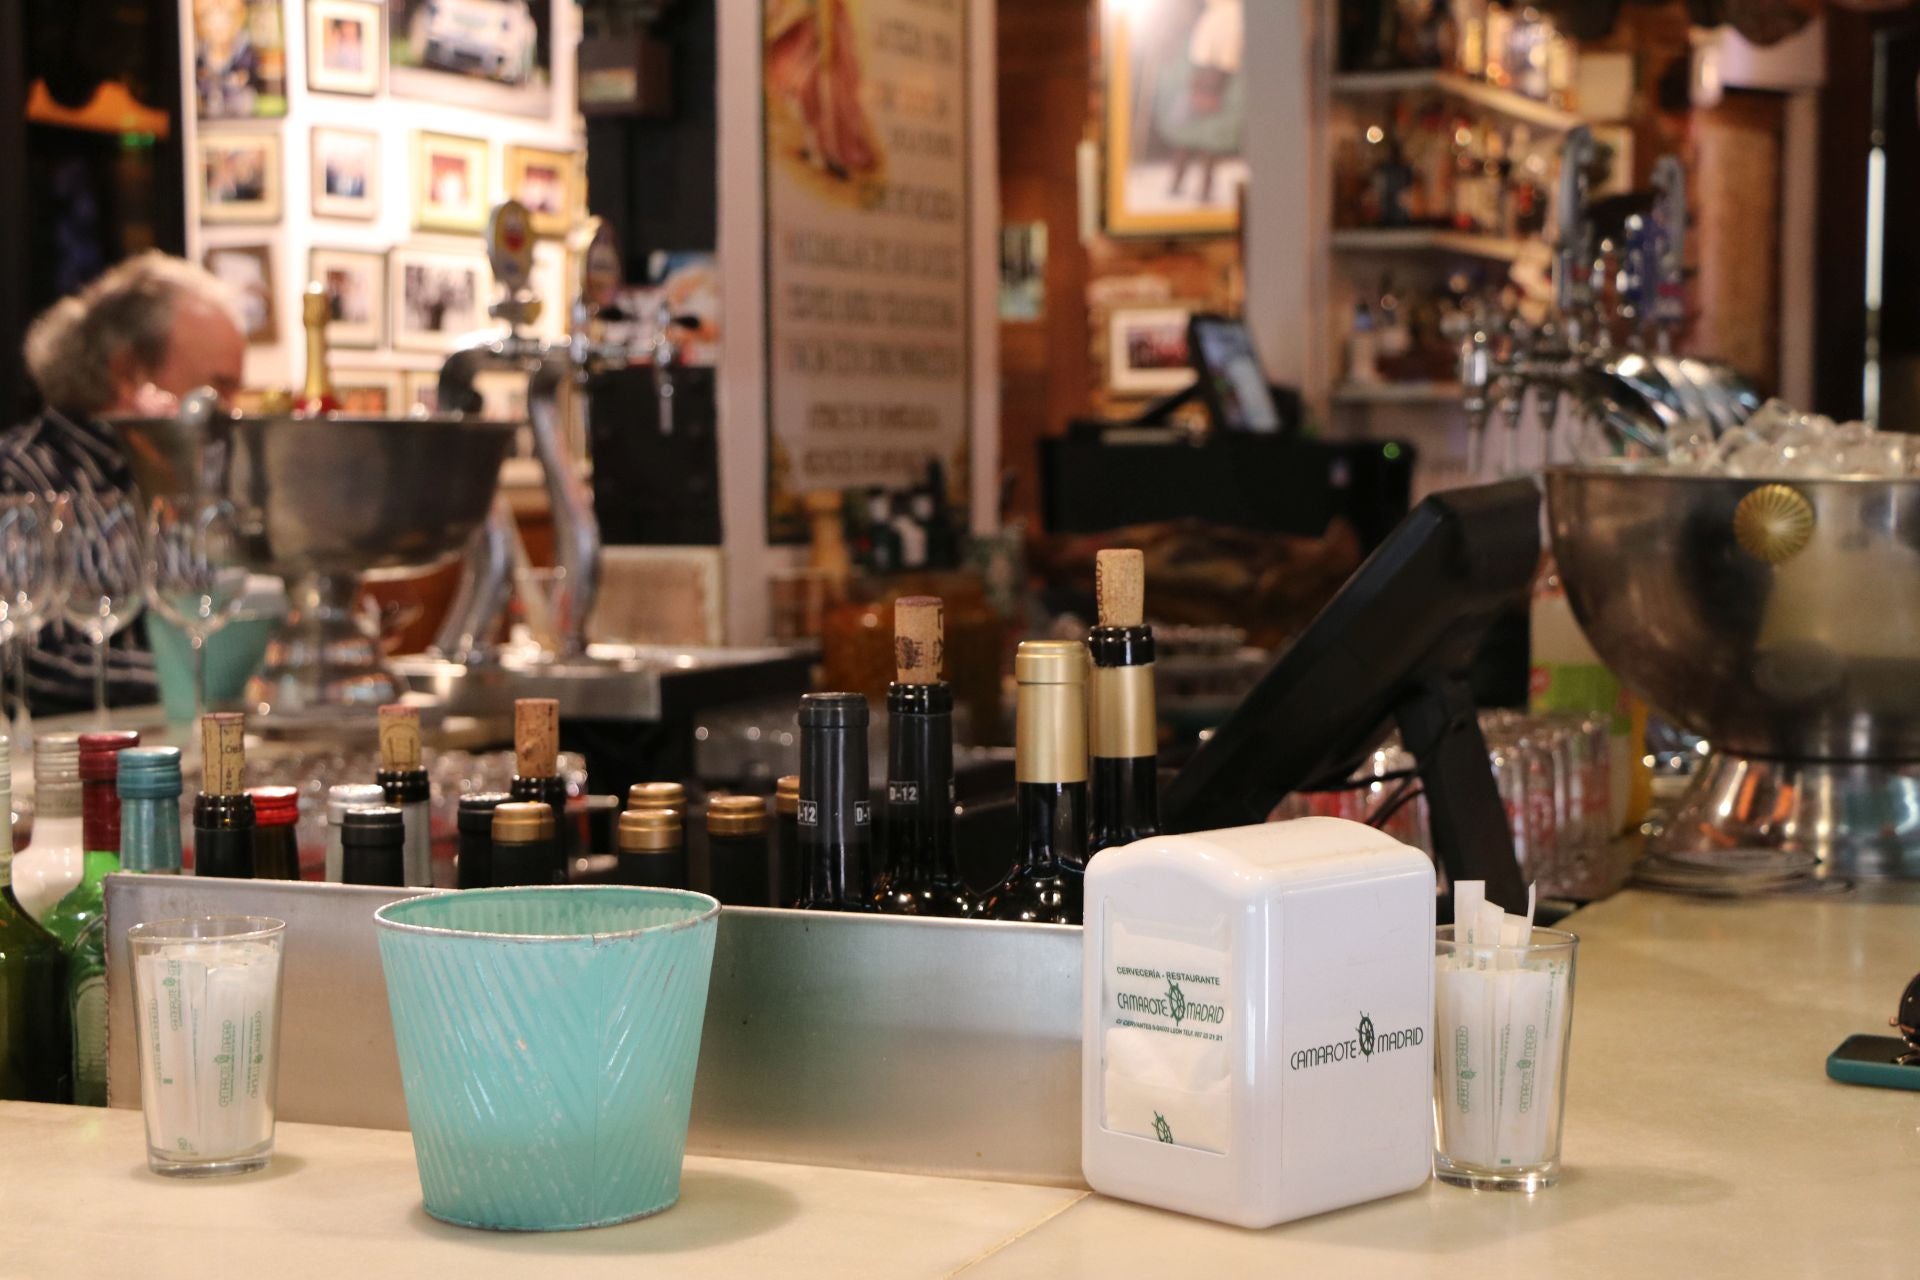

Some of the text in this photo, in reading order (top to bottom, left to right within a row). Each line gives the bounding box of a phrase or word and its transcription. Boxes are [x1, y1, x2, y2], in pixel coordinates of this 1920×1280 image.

[889, 786, 917, 801] D-12
[1116, 966, 1161, 979] CERVECERÍA
[1166, 971, 1221, 986] RESTAURANTE
[1117, 992, 1225, 1025] CAMAROTE MADRID
[1290, 1027, 1424, 1071] CAMAROTE MADRID
[1523, 1024, 1535, 1058] MADRID
